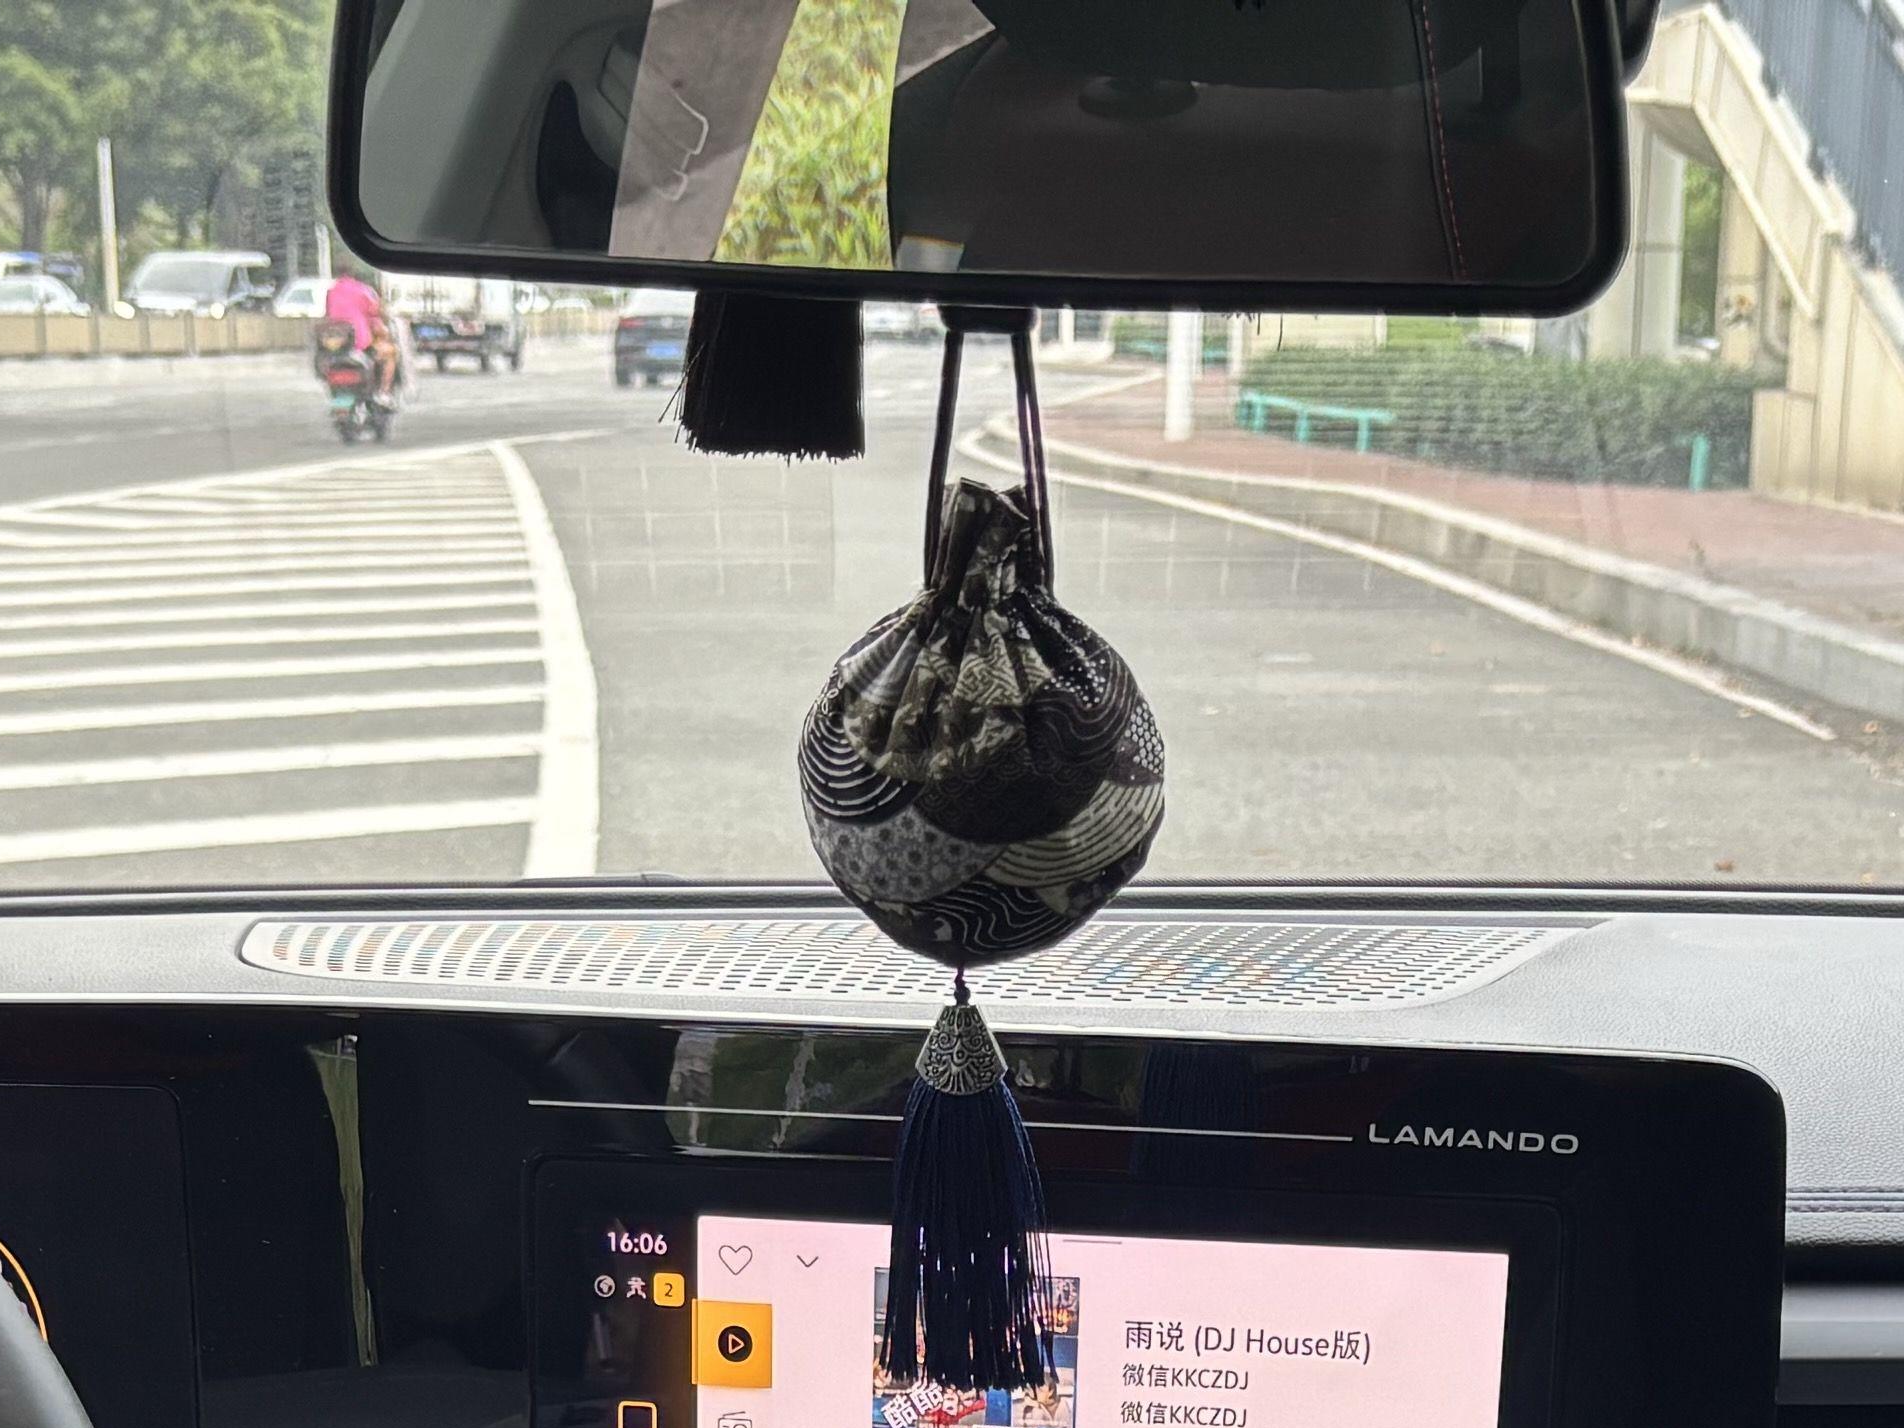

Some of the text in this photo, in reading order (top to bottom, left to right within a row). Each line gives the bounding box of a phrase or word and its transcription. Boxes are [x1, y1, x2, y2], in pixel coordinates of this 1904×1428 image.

[1368, 1123, 1579, 1154] LAMANDO
[607, 1231, 668, 1255] 16:06
[664, 1282, 674, 1298] 2
[1125, 1320, 1371, 1366] 雨说 (DJ House版)
[1122, 1363, 1249, 1390] 微信KKCZDJ
[1121, 1401, 1247, 1428] 微信KKCZDJ
